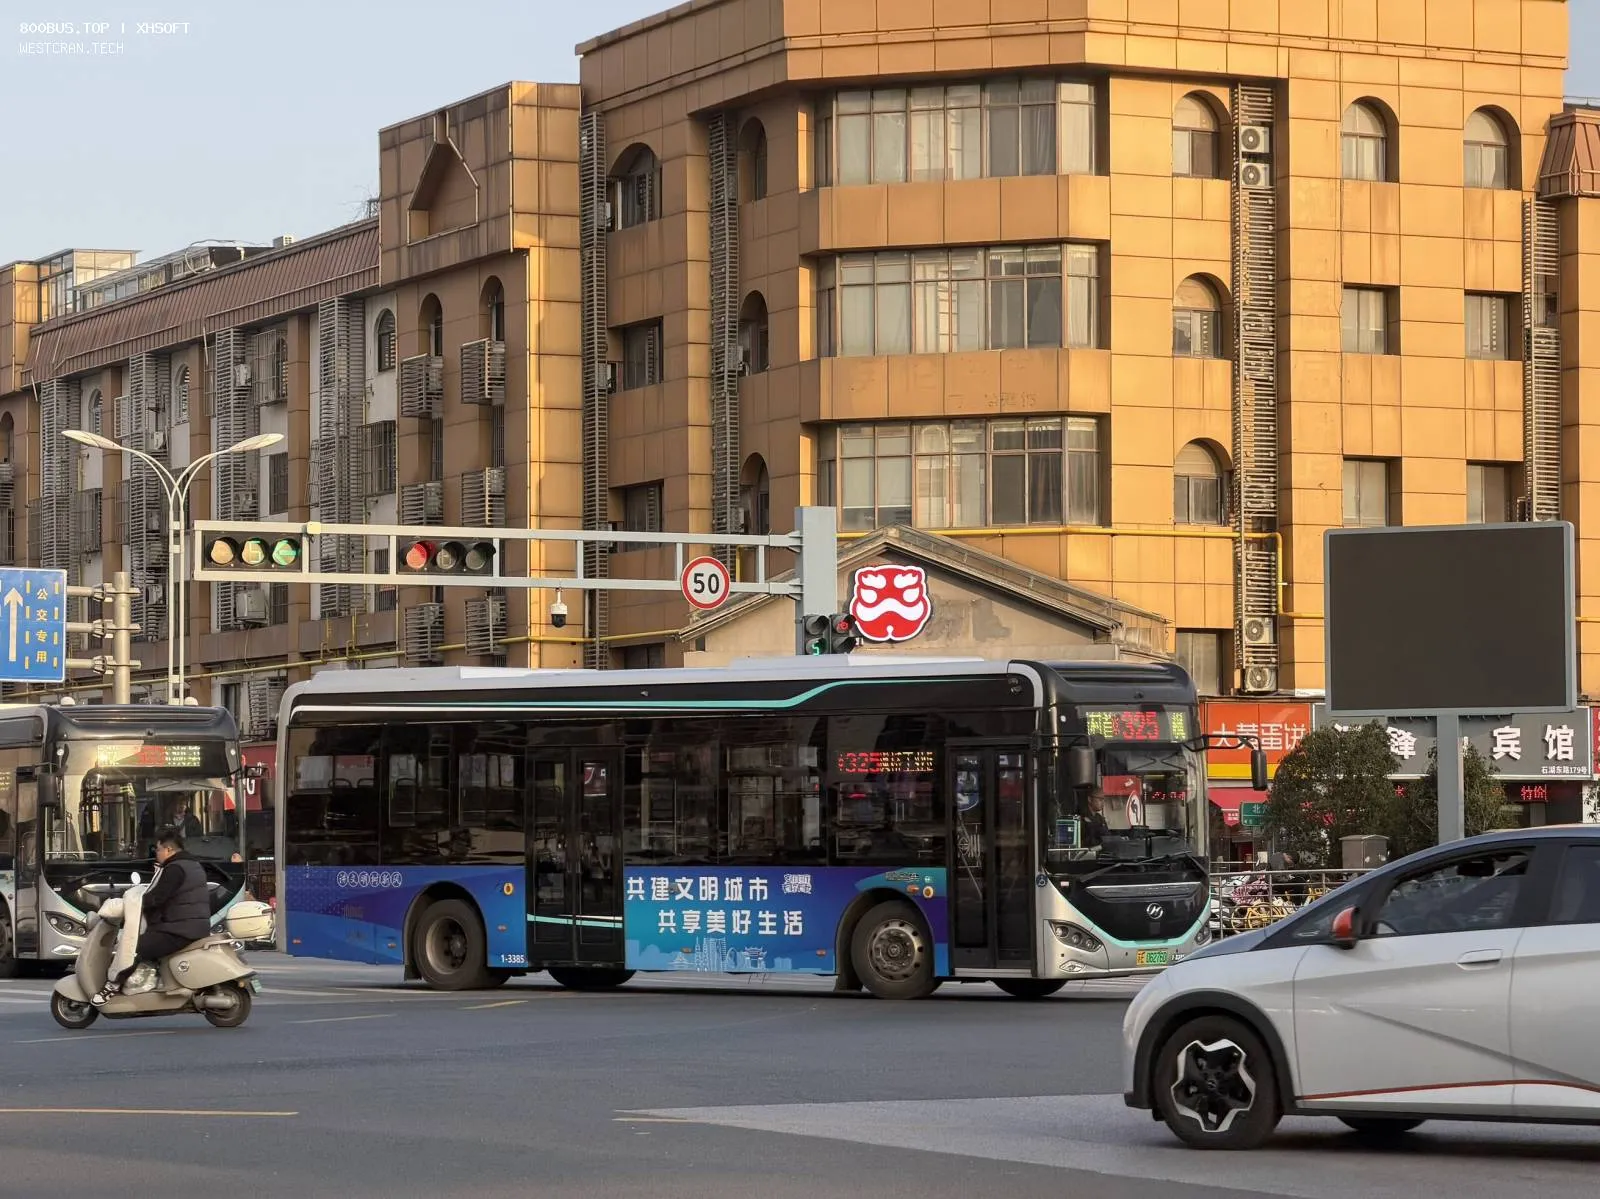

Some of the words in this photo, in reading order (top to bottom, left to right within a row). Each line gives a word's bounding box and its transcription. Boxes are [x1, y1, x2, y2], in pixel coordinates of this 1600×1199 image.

[692, 572, 720, 594] 50
[36, 587, 48, 663] 公交专用
[1541, 765, 1588, 775] 石湖东路179号
[626, 876, 769, 902] 共建文明城市
[657, 909, 804, 936] 共享美好生活
[500, 954, 525, 964] 1-3385
